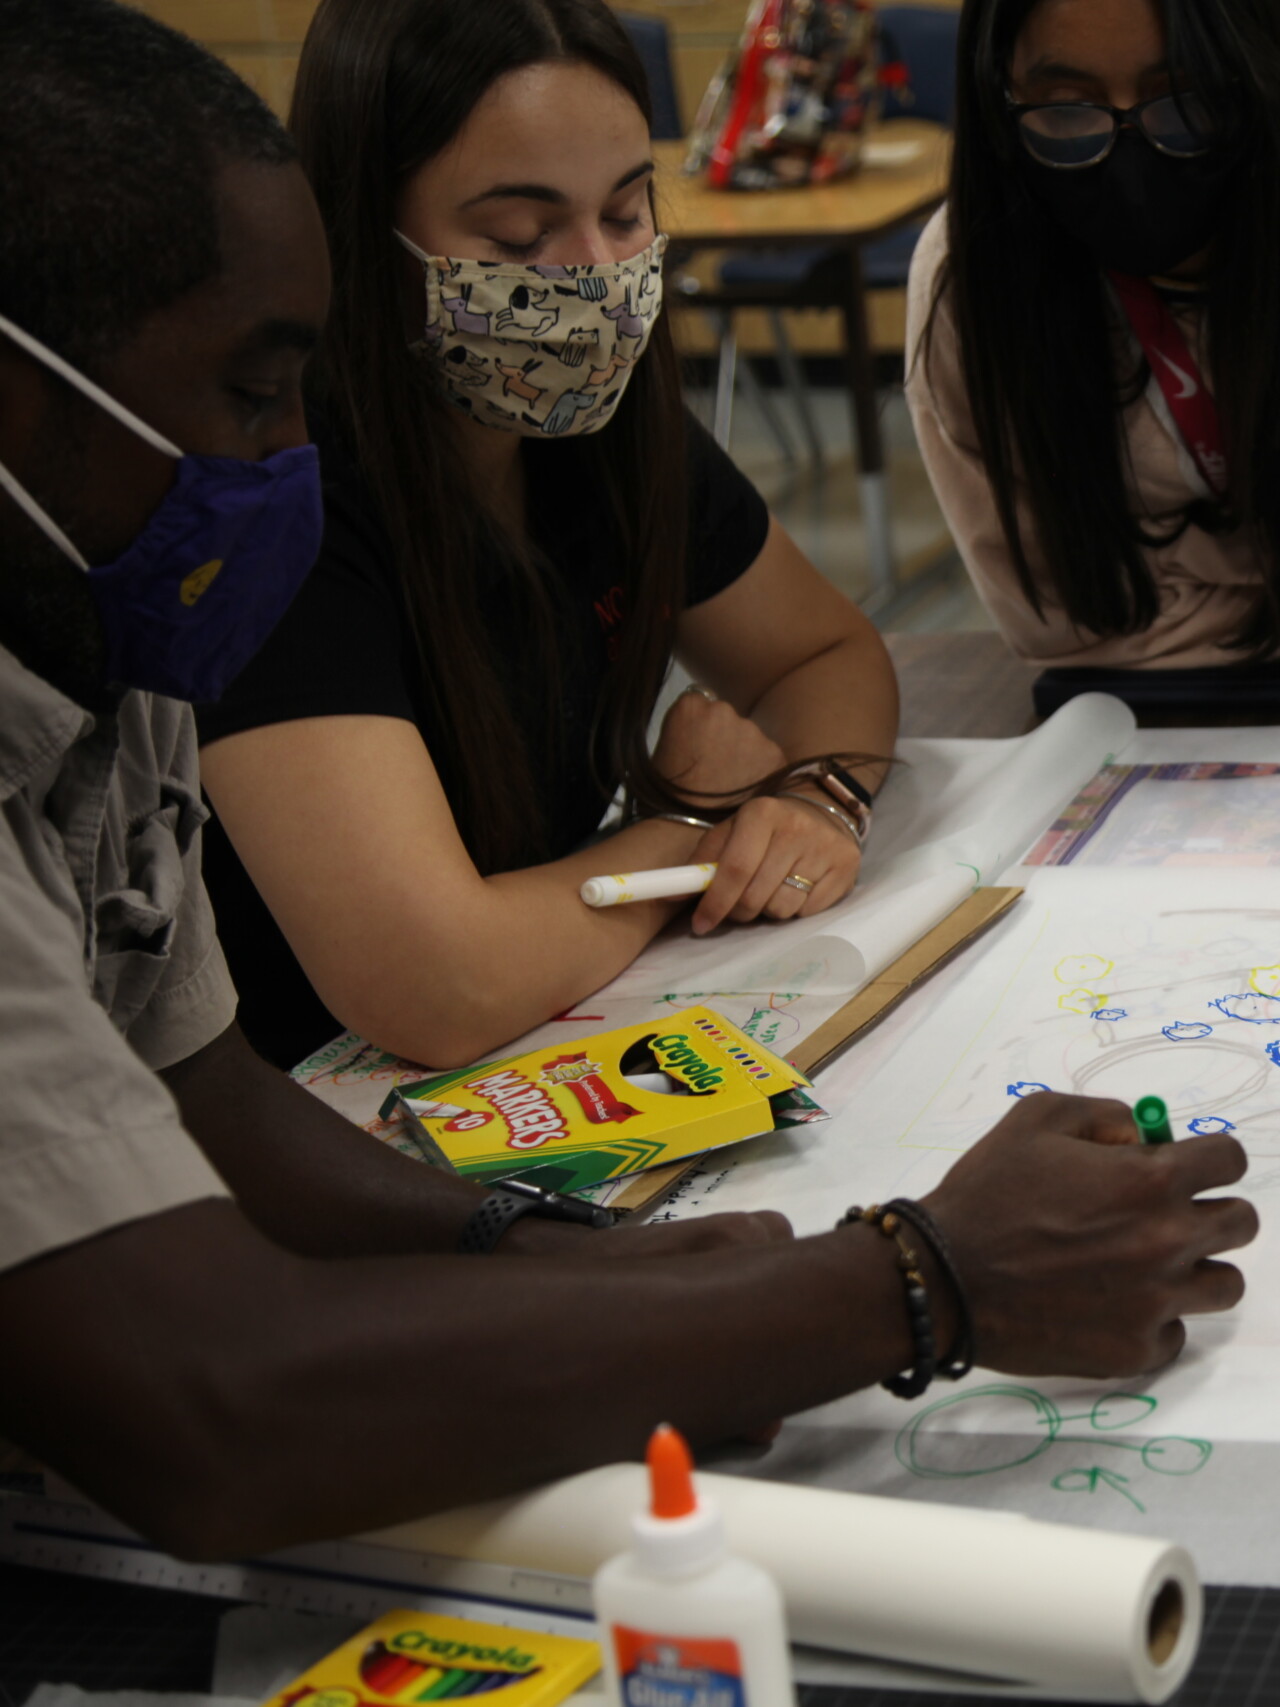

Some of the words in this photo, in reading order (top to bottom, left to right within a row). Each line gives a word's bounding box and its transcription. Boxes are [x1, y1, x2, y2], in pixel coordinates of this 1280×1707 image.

[653, 1034, 723, 1089] Crayola
[454, 1113, 486, 1129] 10
[467, 1071, 565, 1148] MARKERS
[392, 1630, 534, 1666] Crayola
